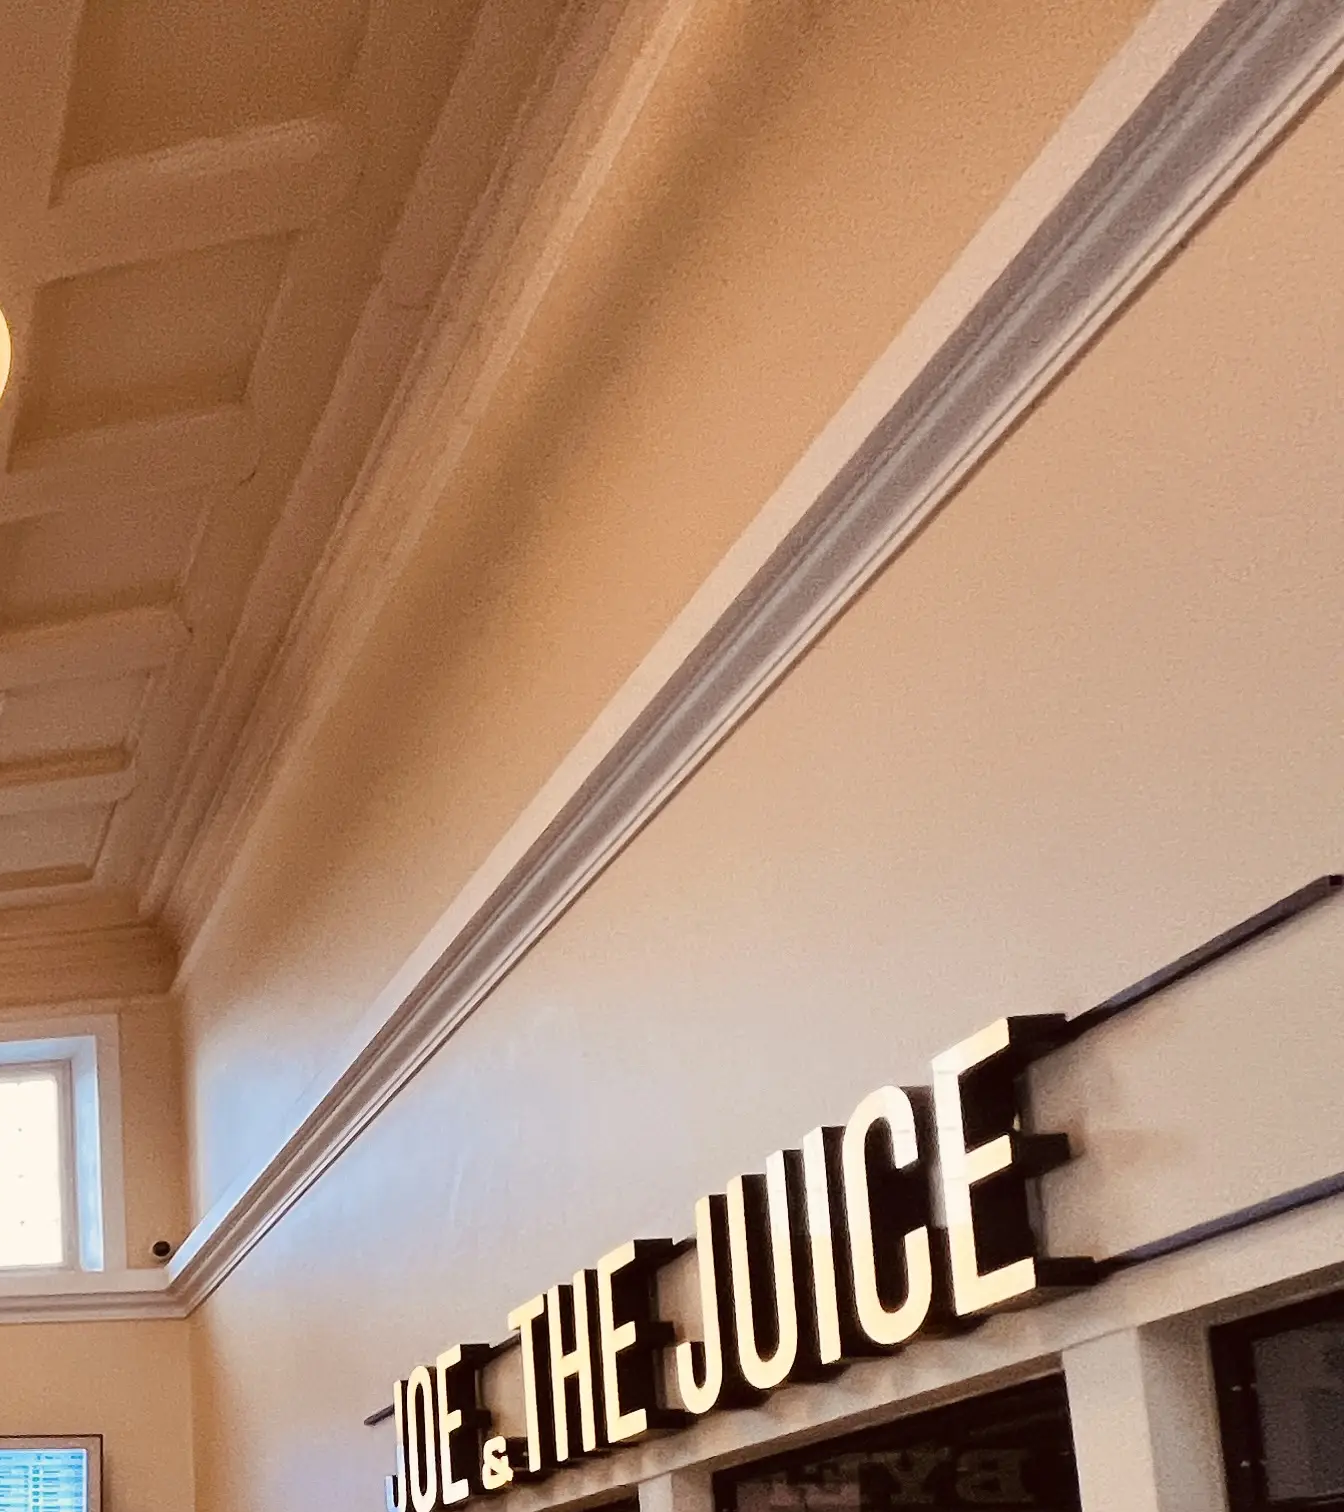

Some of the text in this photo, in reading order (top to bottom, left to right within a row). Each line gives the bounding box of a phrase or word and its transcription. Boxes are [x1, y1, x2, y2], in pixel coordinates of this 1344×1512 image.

[481, 1435, 514, 1491] &
[508, 1243, 648, 1473] THE
[677, 1016, 1037, 1414] JUICE
